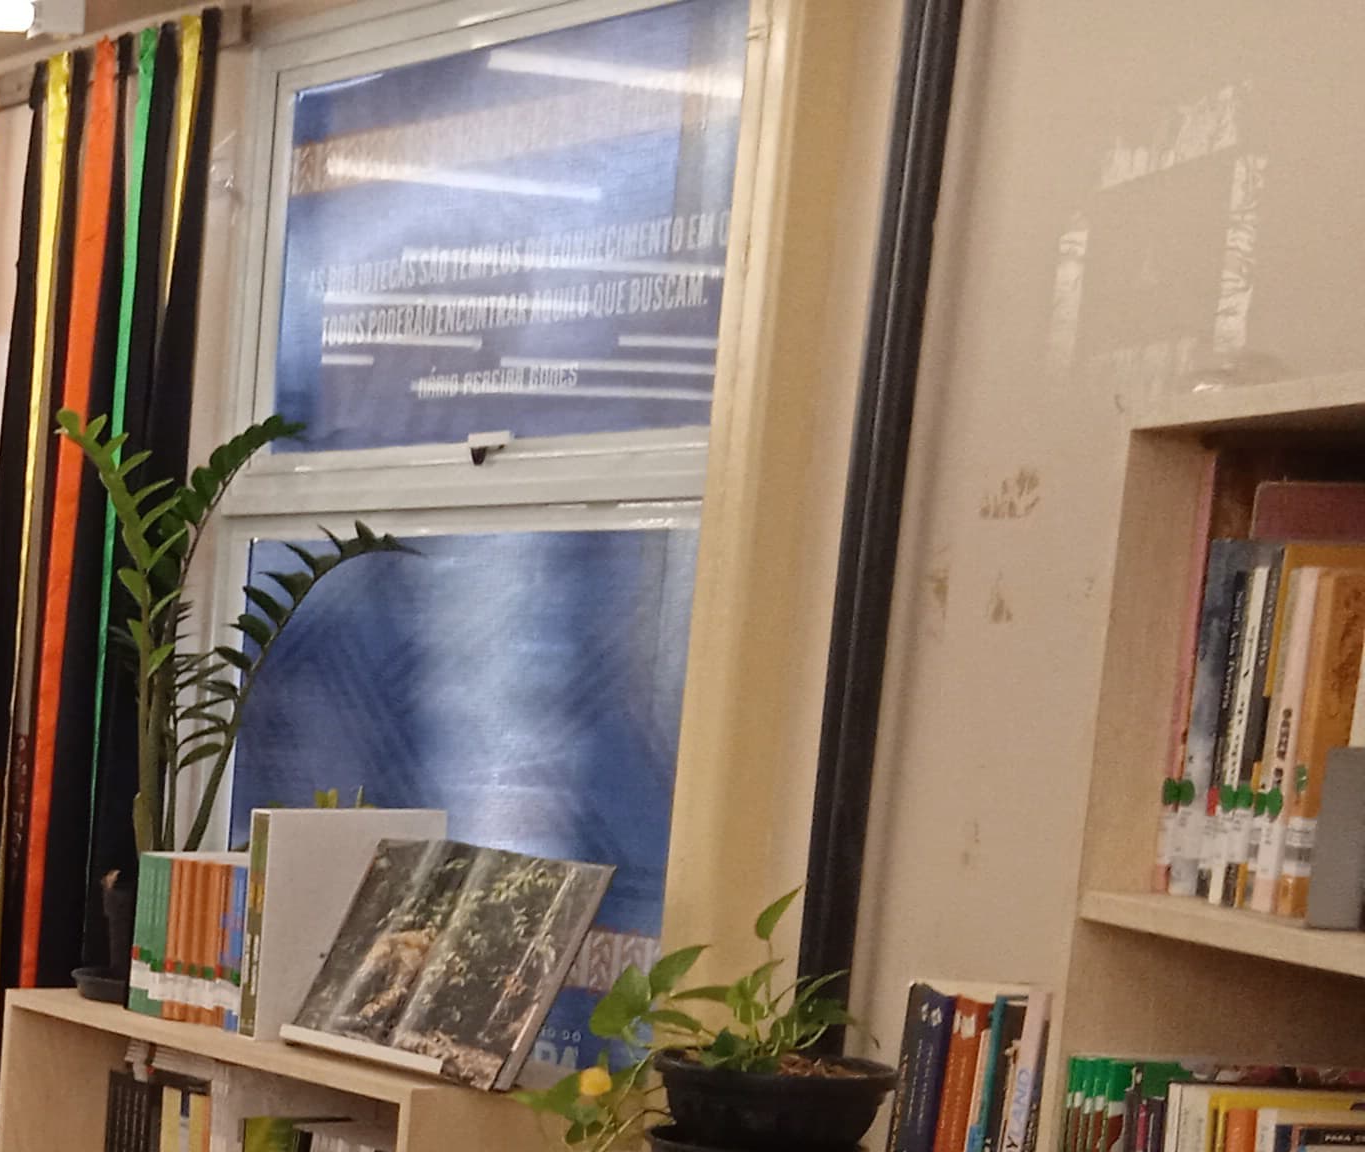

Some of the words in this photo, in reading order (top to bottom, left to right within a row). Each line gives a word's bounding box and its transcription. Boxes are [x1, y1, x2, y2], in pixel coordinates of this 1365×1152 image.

[550, 216, 684, 268] CONHECIMENTO
[686, 213, 715, 249] EM
[322, 311, 366, 346] TODOS
[369, 298, 435, 343] PODERÃO
[436, 293, 528, 333] ENCONTRAR
[593, 280, 627, 319] QUE
